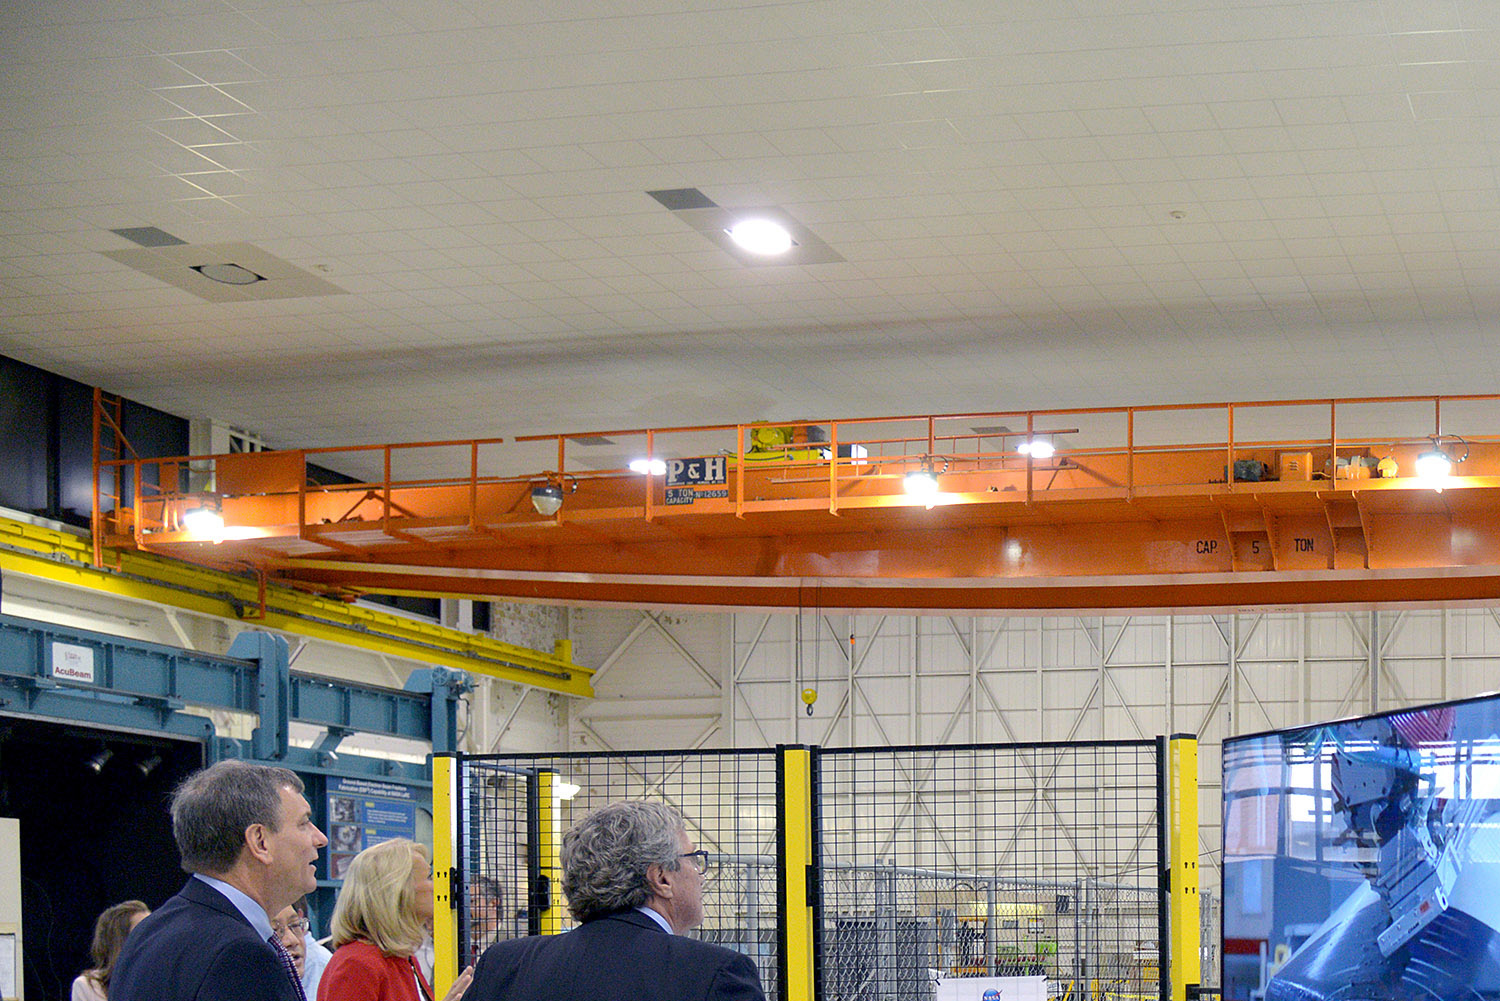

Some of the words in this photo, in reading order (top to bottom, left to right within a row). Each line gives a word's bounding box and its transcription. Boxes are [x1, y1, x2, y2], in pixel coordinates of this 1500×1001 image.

[668, 460, 685, 482] P
[688, 463, 700, 479] &
[704, 458, 724, 481] H
[679, 488, 694, 497] TON
[1196, 540, 1218, 554] CAP.
[1252, 540, 1260, 554] 5
[1294, 538, 1315, 552] TON
[55, 666, 92, 679] AcuBeam
